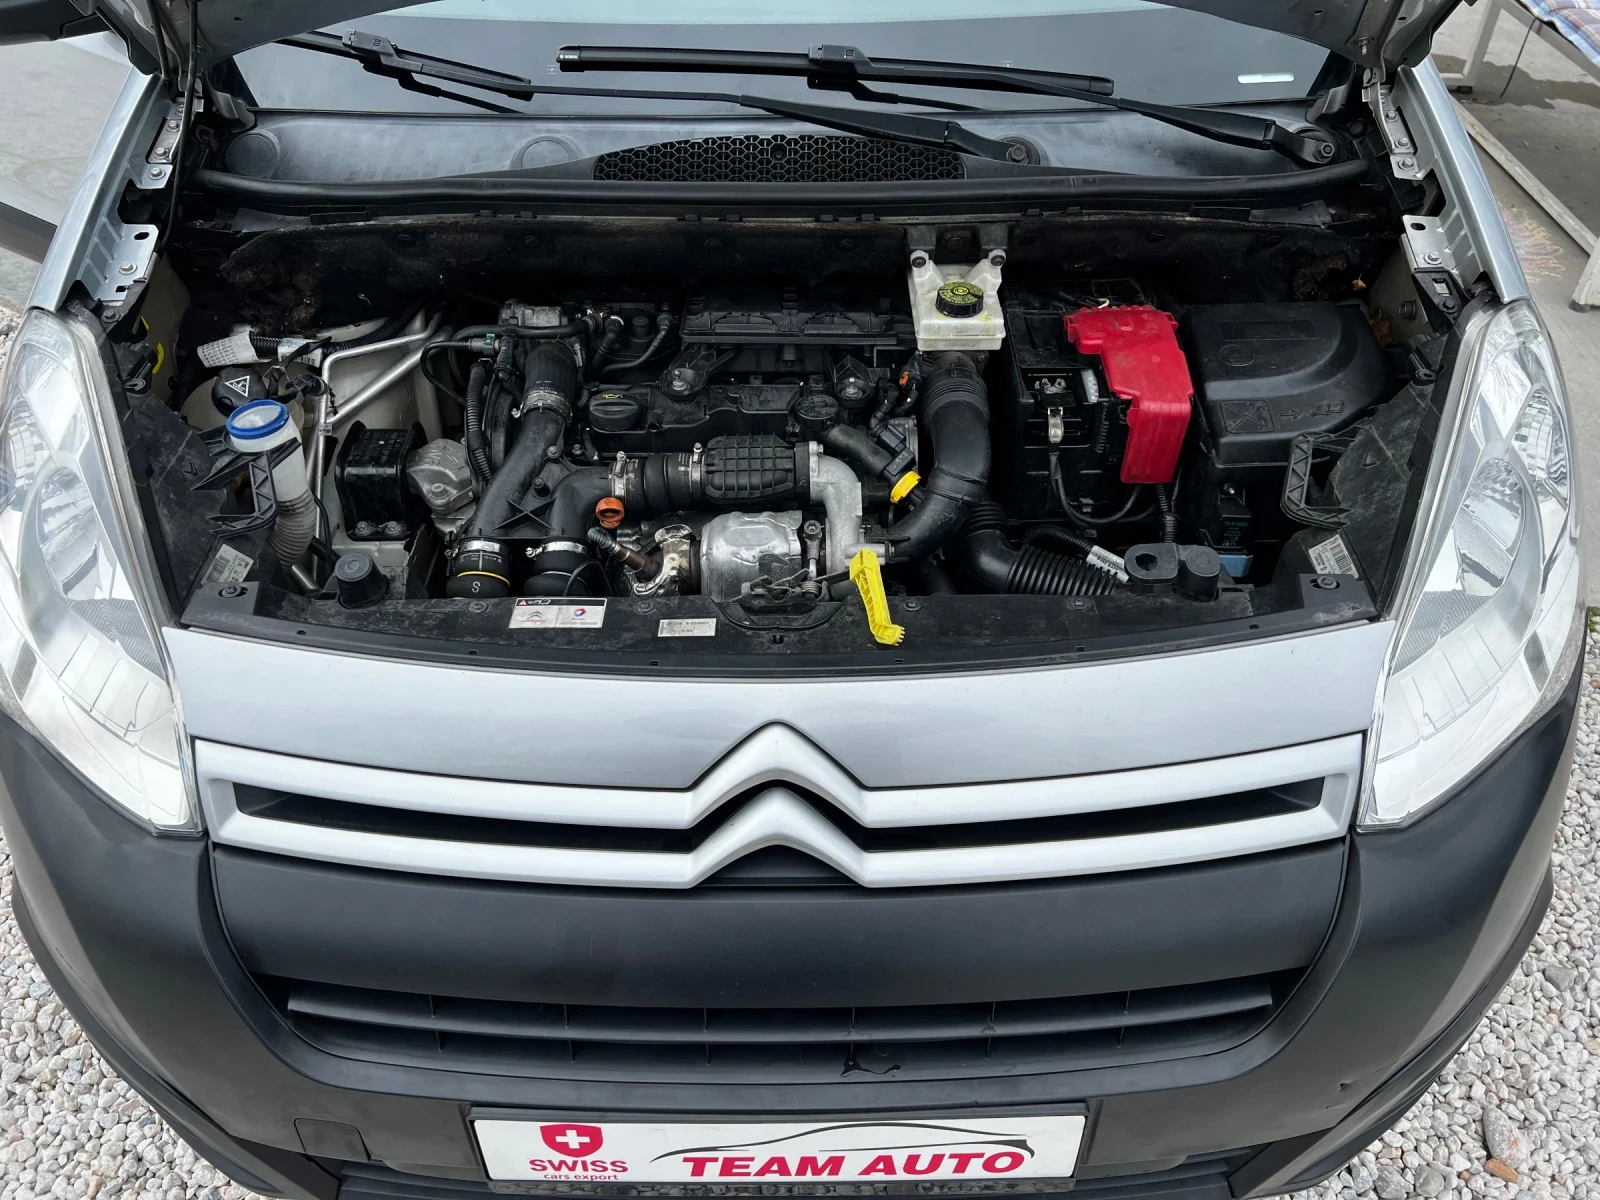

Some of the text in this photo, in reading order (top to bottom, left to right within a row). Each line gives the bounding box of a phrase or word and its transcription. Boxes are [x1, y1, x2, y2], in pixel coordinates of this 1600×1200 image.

[472, 581, 481, 593] S
[529, 1159, 629, 1172] SWISS
[682, 1151, 1026, 1177] TEAM AUTO
